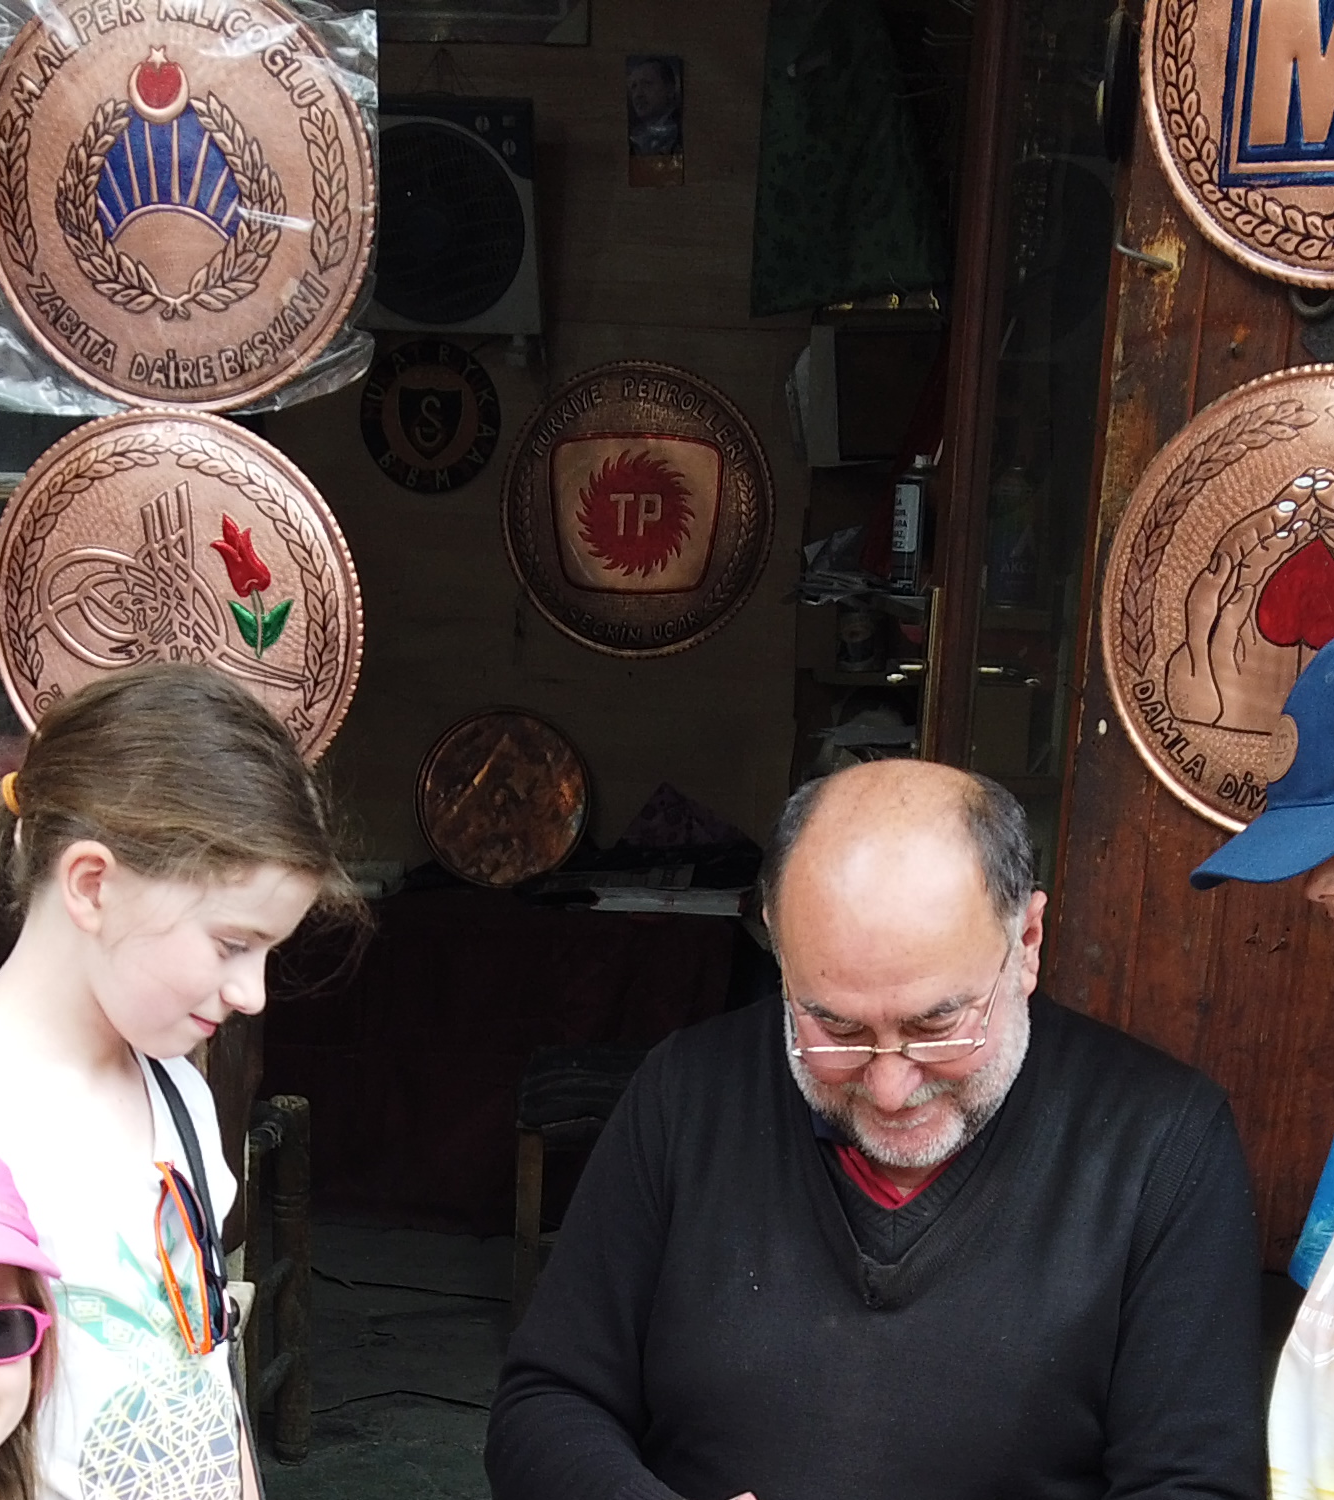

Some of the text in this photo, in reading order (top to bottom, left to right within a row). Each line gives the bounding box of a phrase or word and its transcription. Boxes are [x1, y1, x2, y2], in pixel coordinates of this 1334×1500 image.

[25, 270, 331, 389] ZABITA DAİRE BAŞKANI
[609, 492, 664, 538] TP
[1133, 679, 1267, 815] DAMLA DİY
